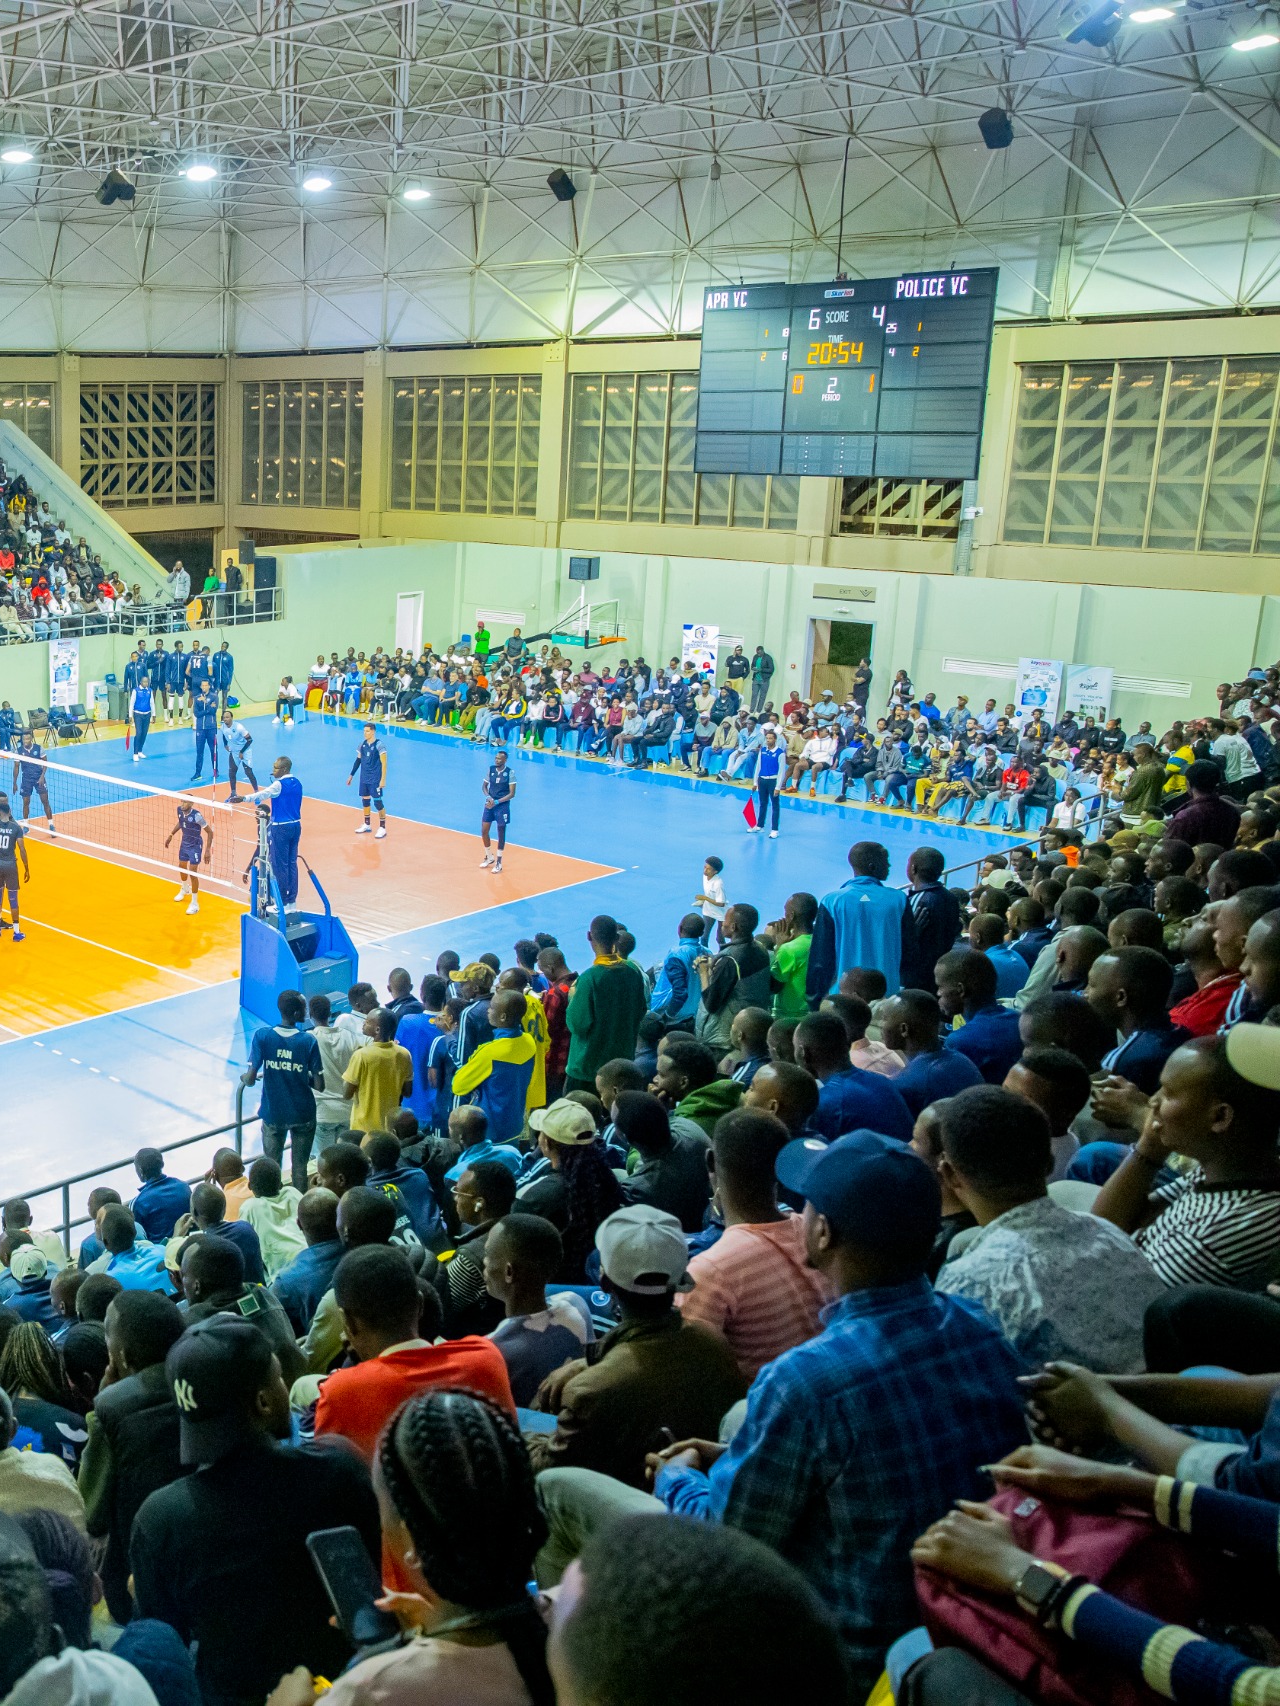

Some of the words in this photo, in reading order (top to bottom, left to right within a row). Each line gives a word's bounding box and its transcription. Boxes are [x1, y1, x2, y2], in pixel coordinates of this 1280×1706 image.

[895, 278, 945, 298] POLICE
[951, 276, 969, 295] VC
[706, 292, 728, 309] APR
[733, 291, 747, 308] VC
[808, 309, 821, 330] 6
[825, 310, 849, 323] SCORE
[872, 305, 886, 326] 4
[885, 322, 897, 333] 25
[828, 334, 844, 343] TIME
[807, 341, 864, 365] 20:54
[888, 347, 895, 357] 4
[911, 345, 920, 357] 2
[792, 374, 804, 394] 0
[826, 377, 838, 394] 2
[868, 373, 875, 393] 1
[821, 393, 841, 402] PERIOD
[192, 658, 201, 668] 14
[276, 1049, 292, 1059] FAN
[265, 1060, 292, 1071] POLICE
[292, 1063, 304, 1072] FC
[174, 1378, 198, 1411] NY
